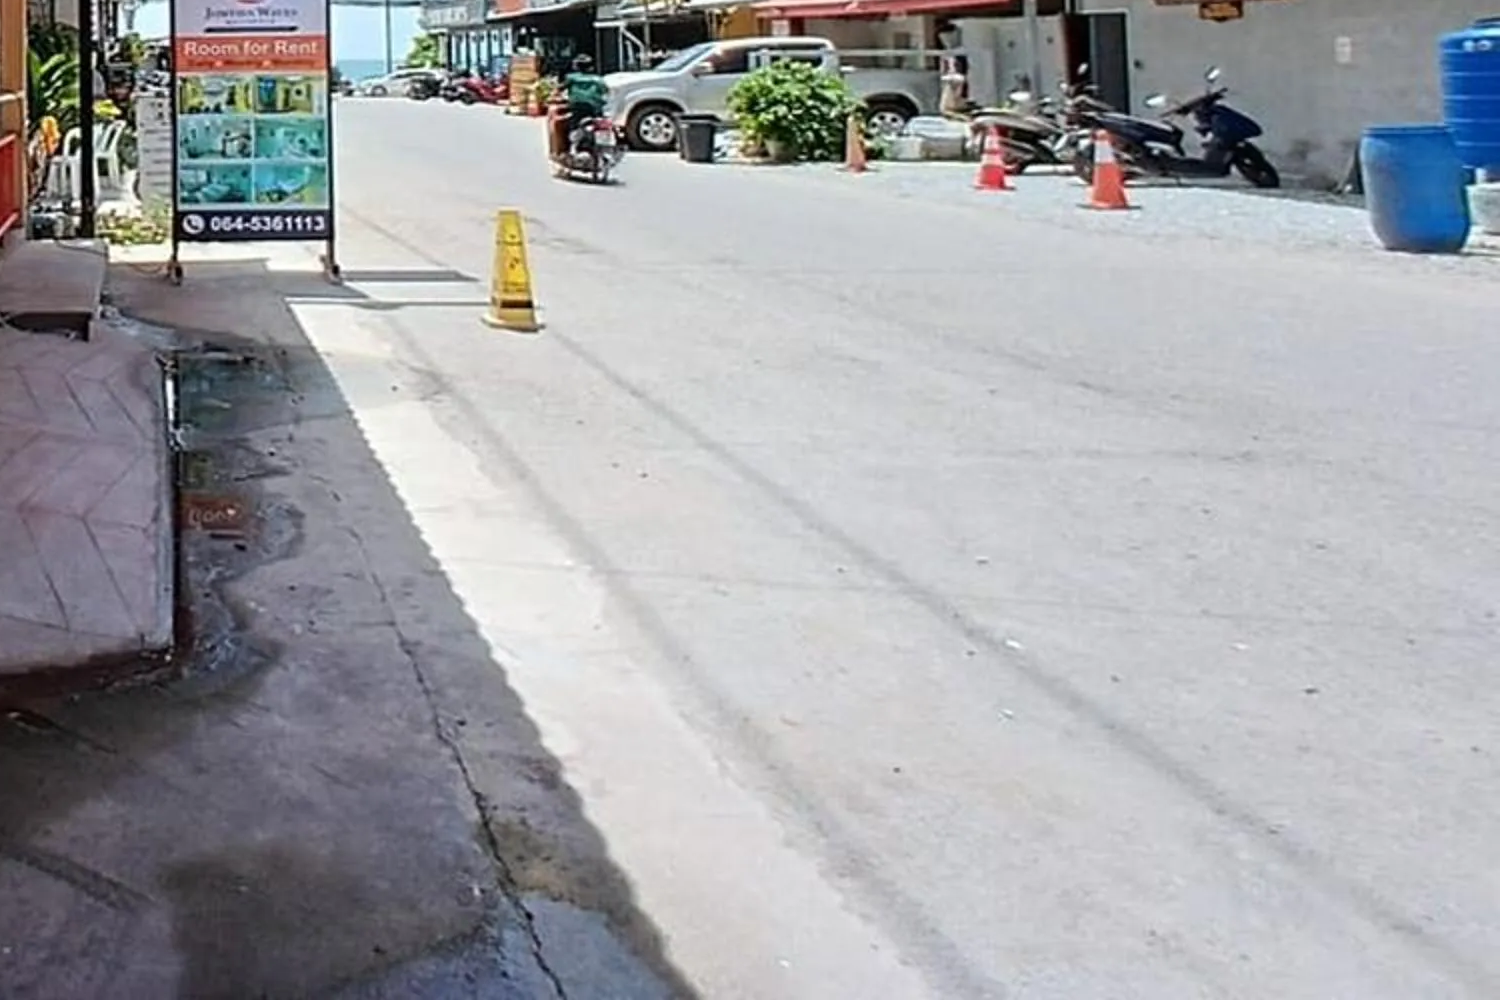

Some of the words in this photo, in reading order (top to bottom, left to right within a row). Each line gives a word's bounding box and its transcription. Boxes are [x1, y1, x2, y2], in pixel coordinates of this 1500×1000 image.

[184, 41, 239, 56] Room
[243, 40, 269, 55] for
[273, 39, 318, 55] Rent
